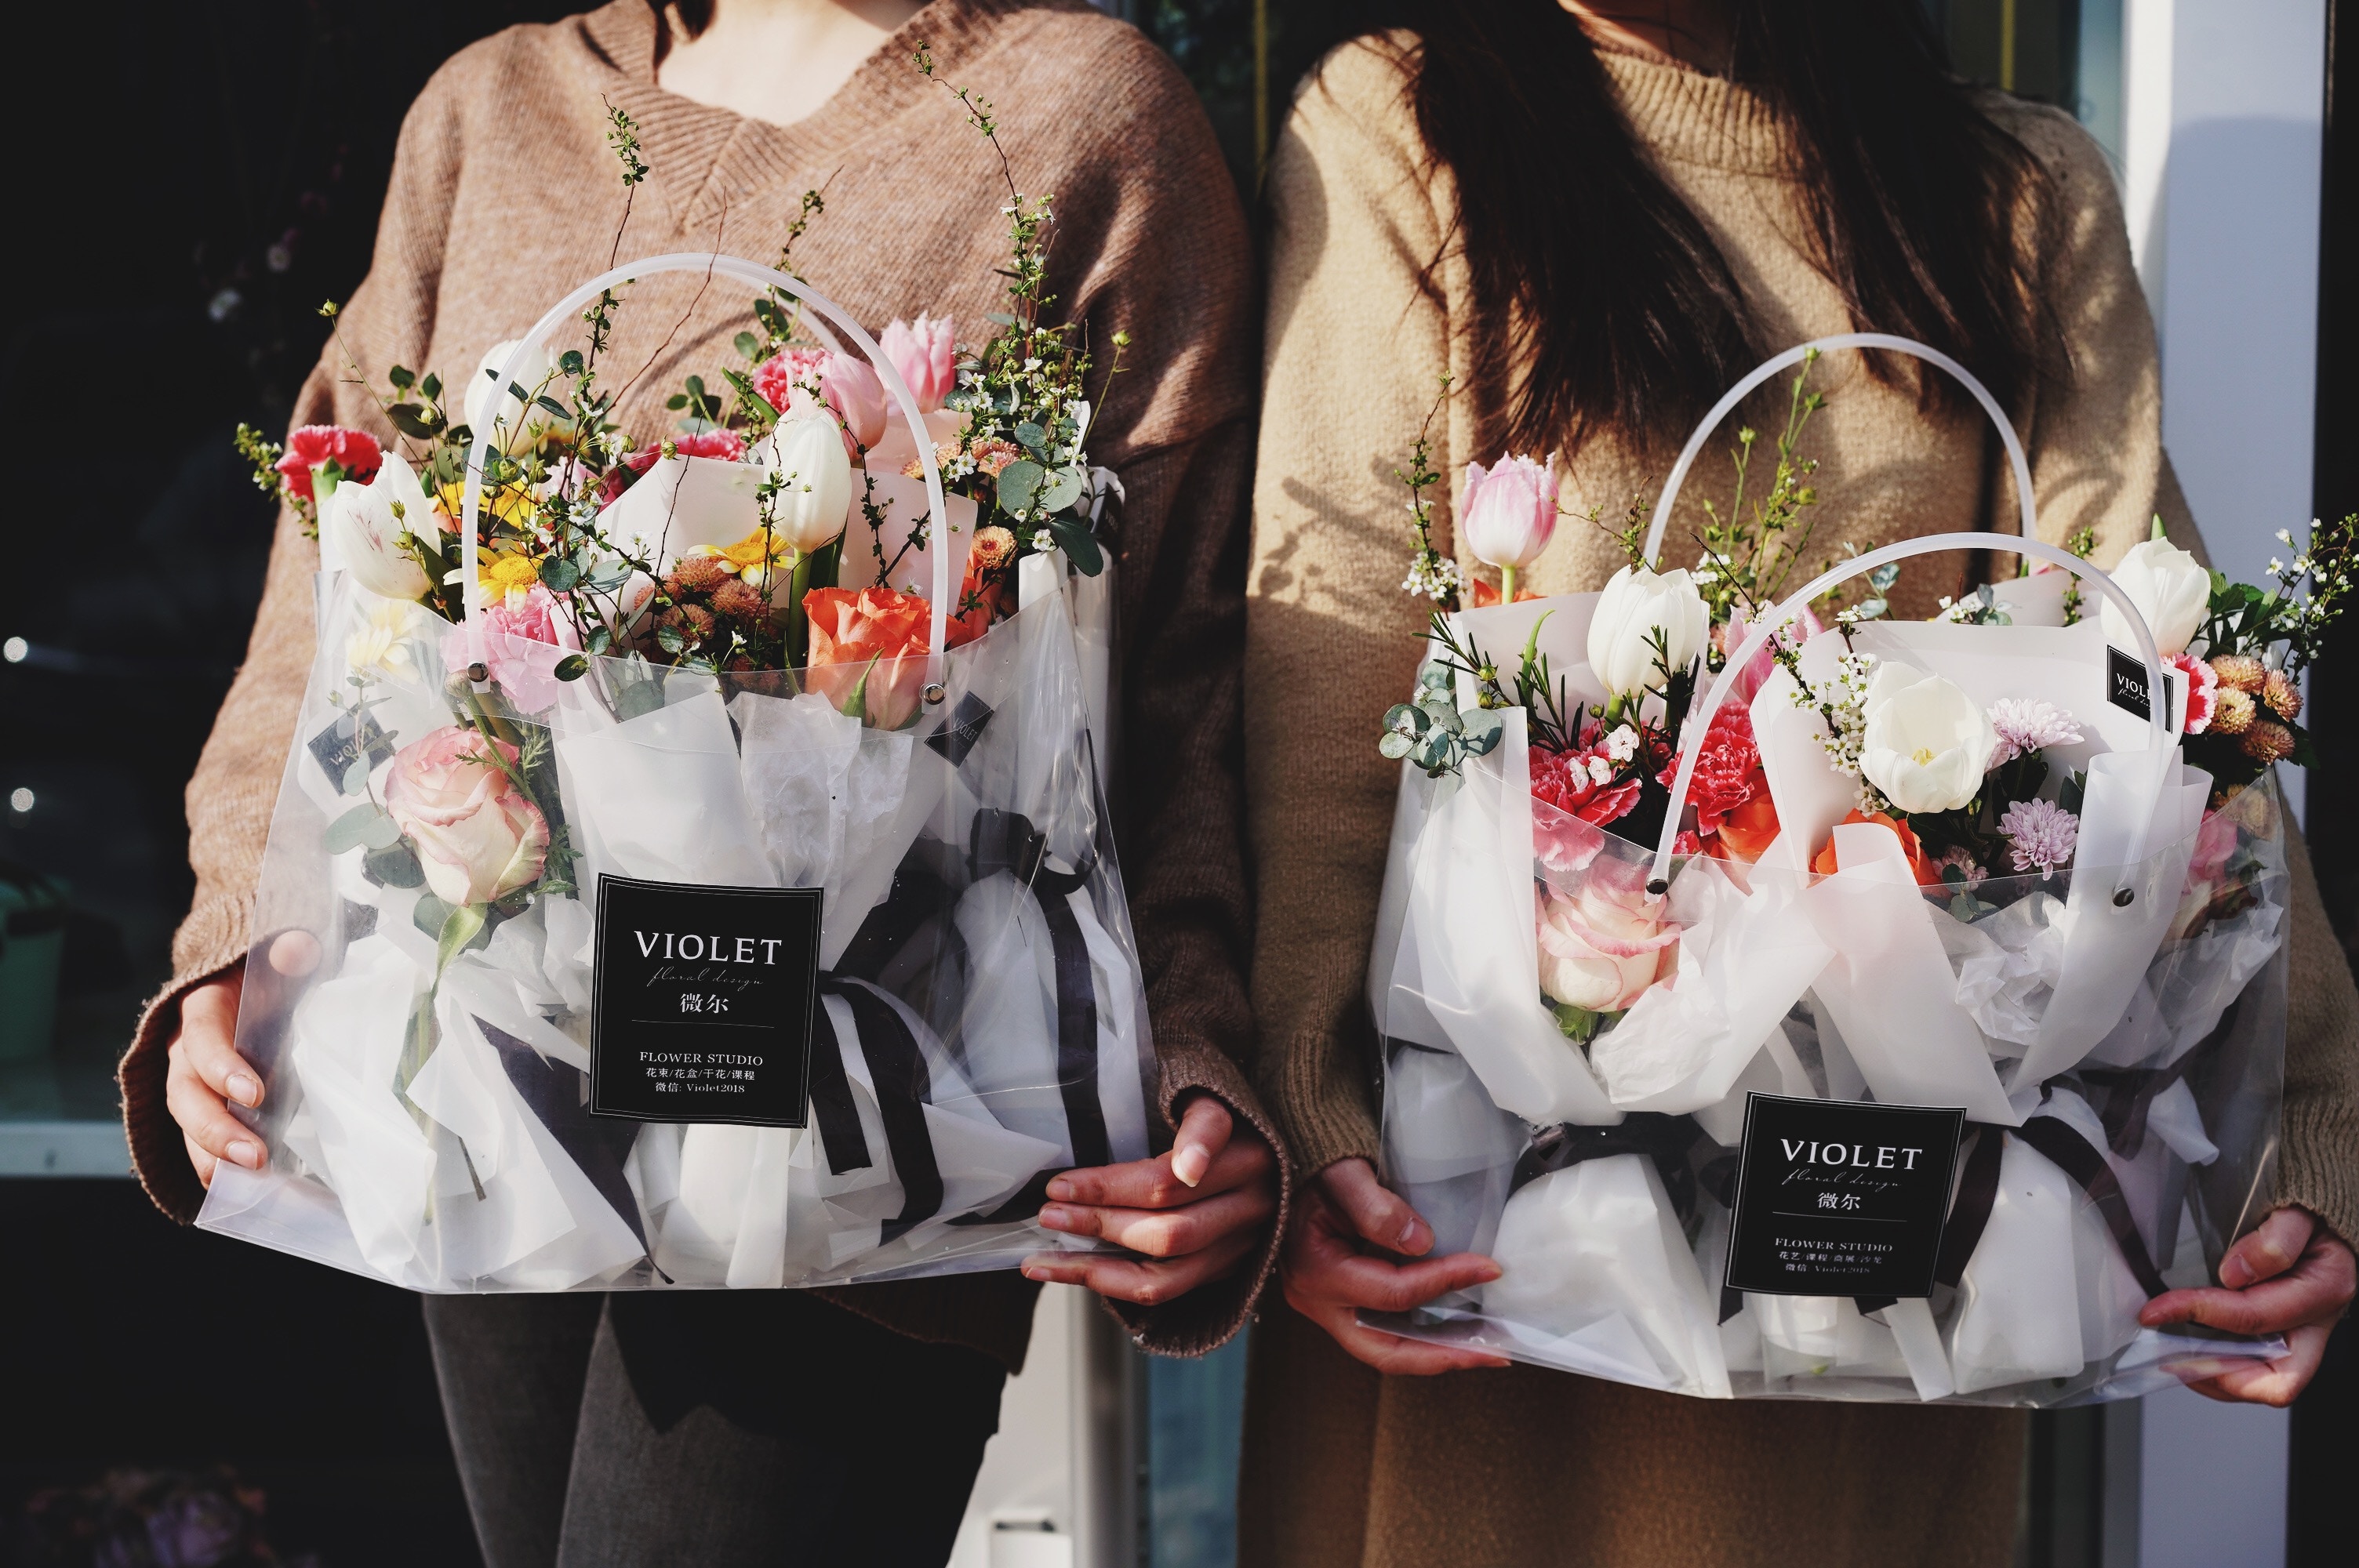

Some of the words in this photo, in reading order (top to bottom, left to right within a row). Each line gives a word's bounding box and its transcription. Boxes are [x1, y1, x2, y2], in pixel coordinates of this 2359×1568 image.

[634, 930, 783, 966] VIOLET
[646, 966, 711, 988] floral
[712, 968, 764, 992] design
[679, 993, 729, 1014] 微尔
[639, 1051, 703, 1064] FLOWER
[707, 1054, 763, 1066] STUDIO
[687, 1083, 745, 1093] Violet2018
[1780, 1138, 1923, 1170] VIOLET
[1781, 1168, 1846, 1185] floral
[1849, 1173, 1901, 1193] design
[1816, 1192, 1861, 1210] 微尔
[1775, 1237, 1834, 1250] FLOWER
[1840, 1242, 1893, 1253] STUDIO
